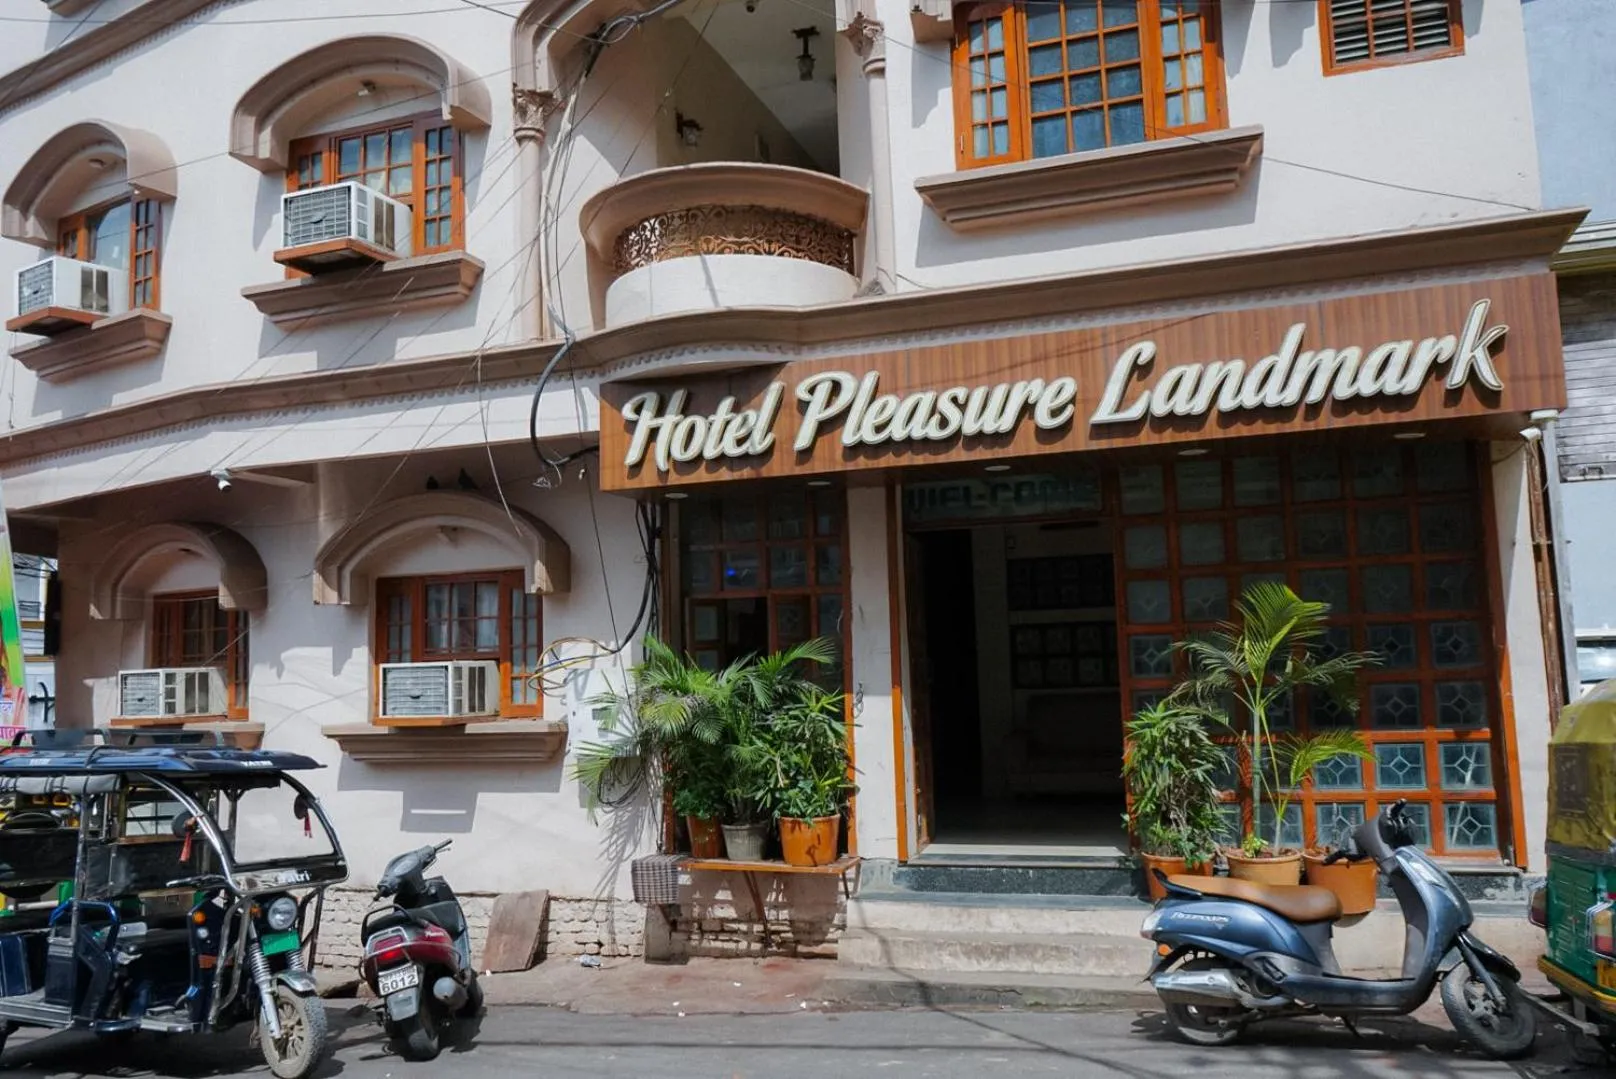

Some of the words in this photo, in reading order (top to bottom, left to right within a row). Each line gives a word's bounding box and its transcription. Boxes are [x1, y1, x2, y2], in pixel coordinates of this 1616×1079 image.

[621, 380, 785, 472] Hotel
[793, 369, 1078, 453] Pleasure
[1089, 298, 1510, 425] Landmark
[381, 974, 417, 993] 6012
